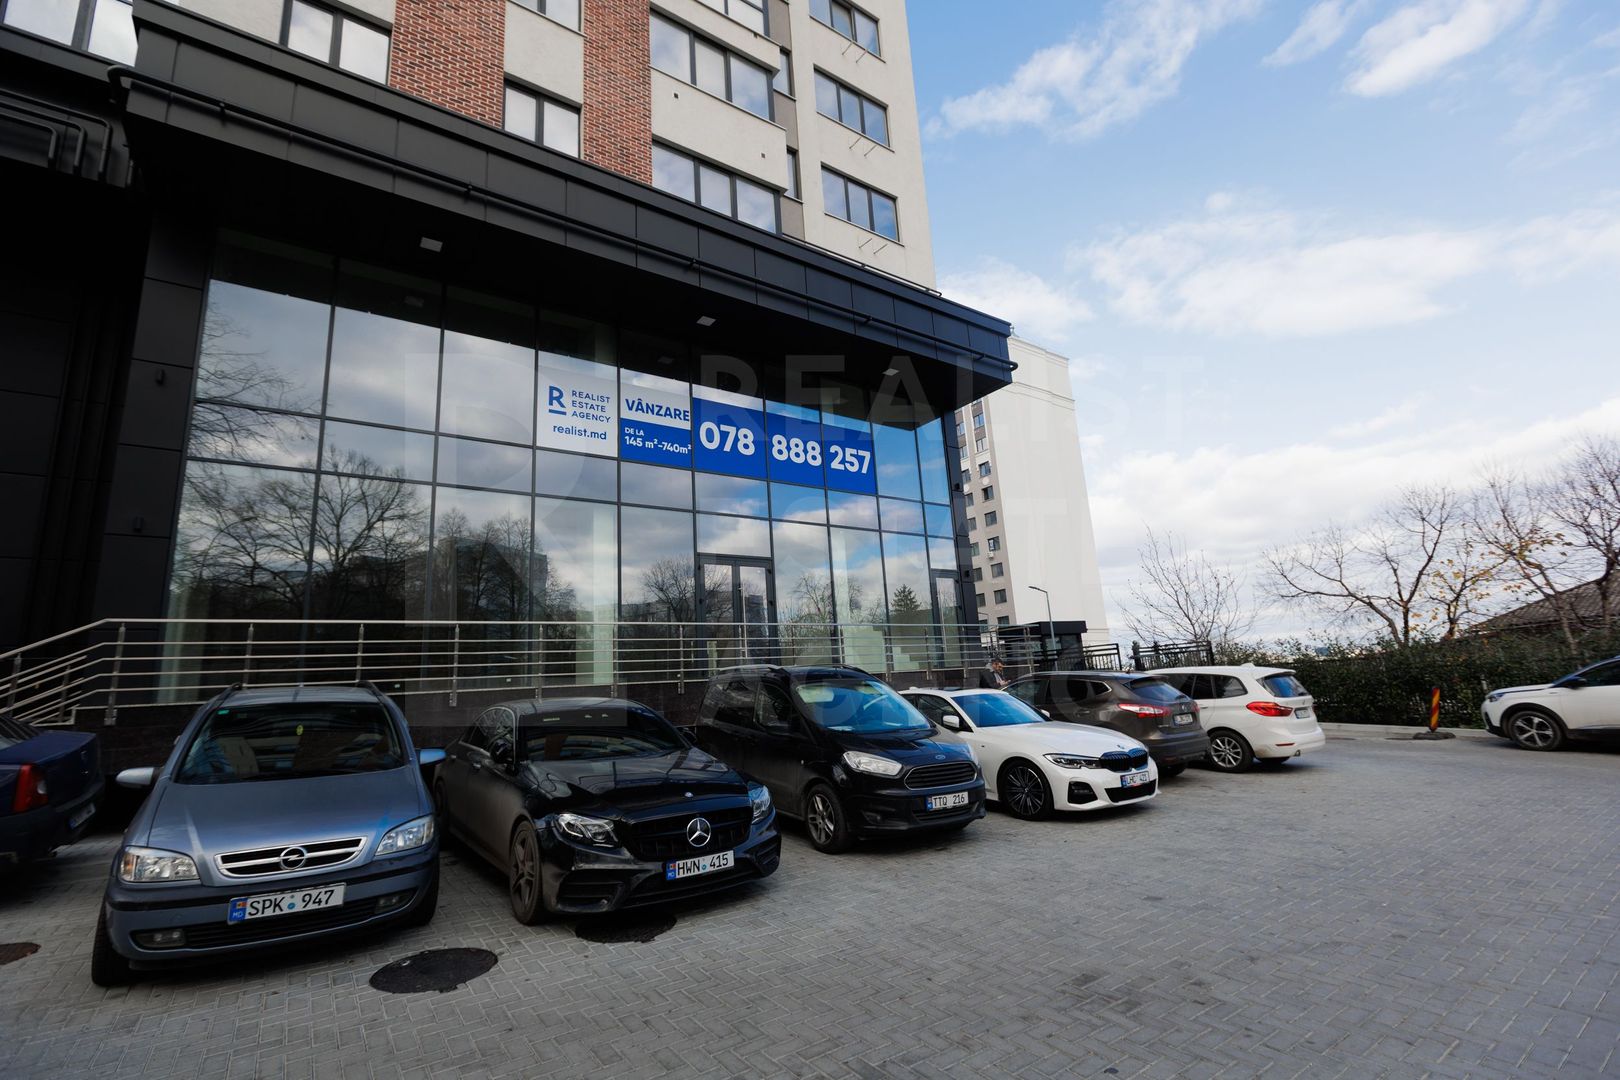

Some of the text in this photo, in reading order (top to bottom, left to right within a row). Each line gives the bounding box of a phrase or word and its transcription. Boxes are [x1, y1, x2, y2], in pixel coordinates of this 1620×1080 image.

[571, 390, 610, 403] REALIST
[571, 400, 606, 412] ESTATE
[625, 398, 690, 422] VÂNZARE
[571, 410, 611, 423] AGENCY
[553, 424, 607, 440] realist.md
[624, 436, 643, 447] 145
[700, 421, 871, 474] 078 888 257
[933, 796, 948, 807] TTQ
[952, 794, 965, 805] 216
[677, 853, 729, 876] HWN 415
[248, 889, 336, 917] SPK 947
